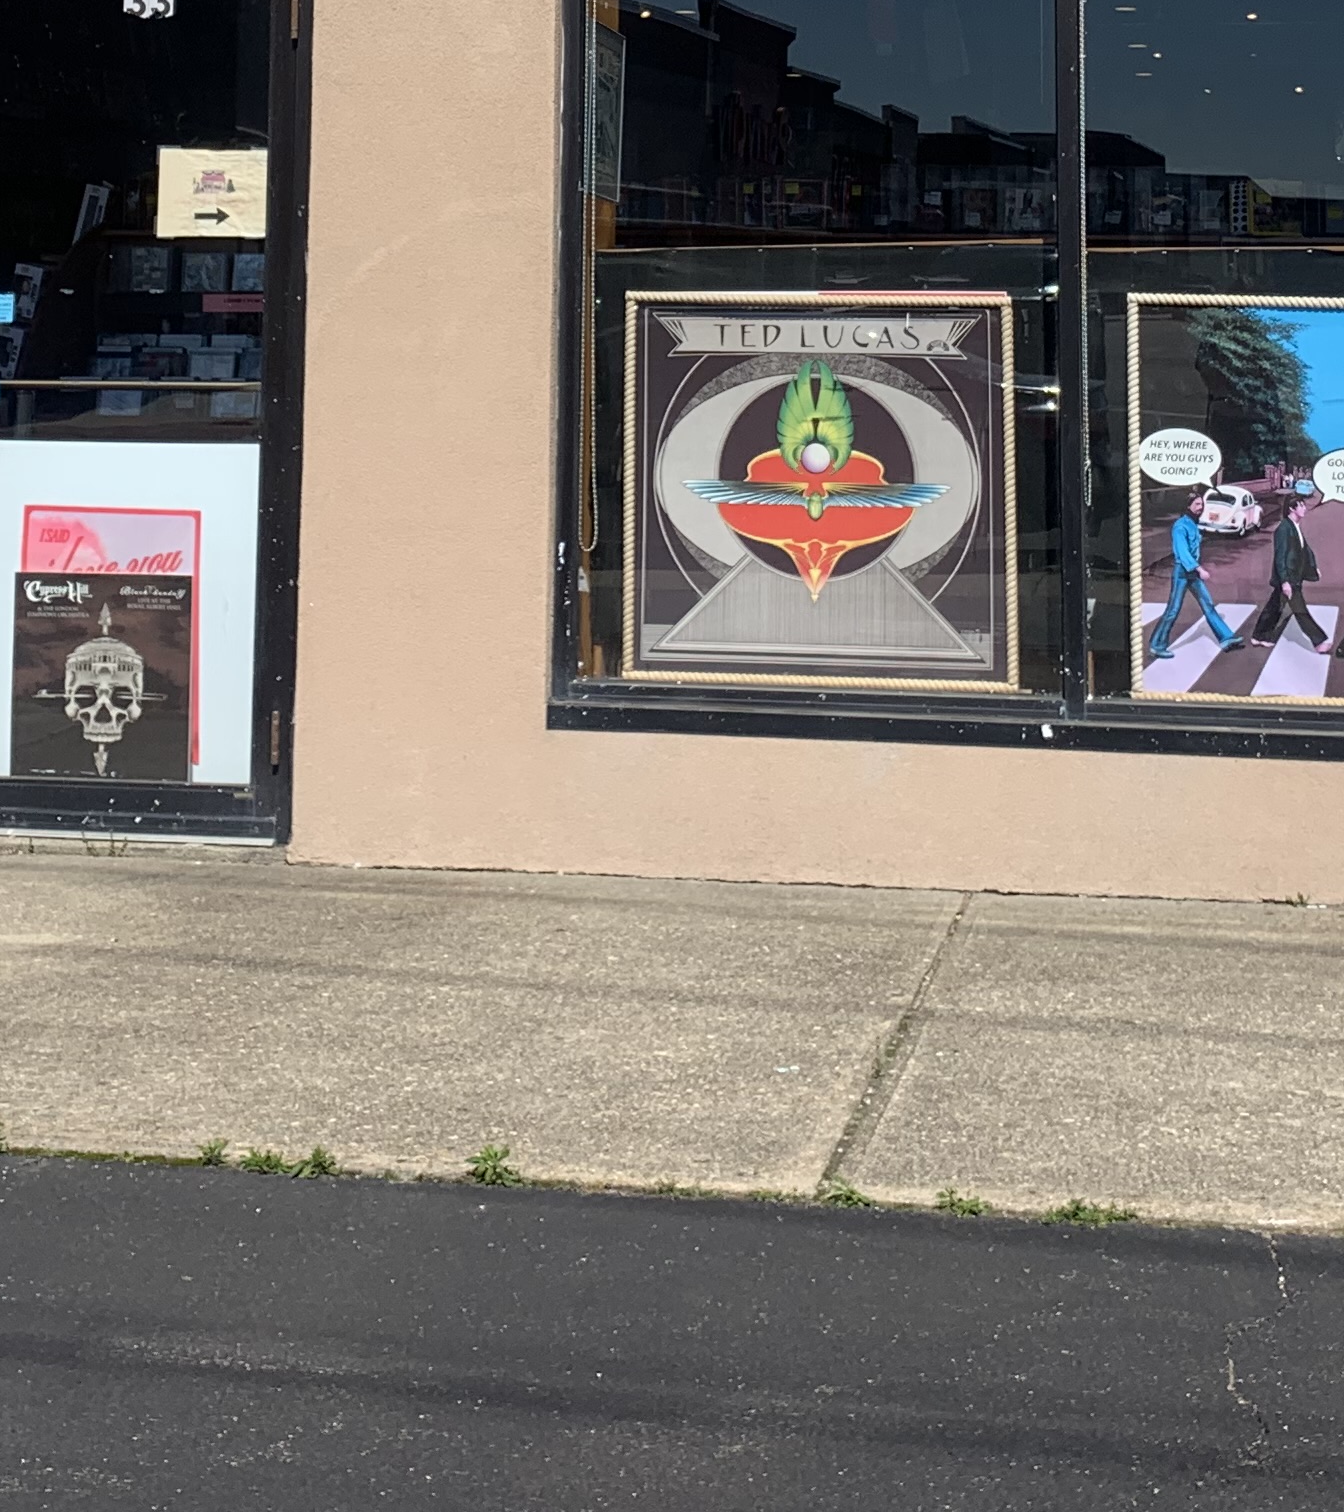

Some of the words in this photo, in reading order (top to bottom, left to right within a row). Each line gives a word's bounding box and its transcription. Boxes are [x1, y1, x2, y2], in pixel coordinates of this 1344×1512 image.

[713, 323, 781, 348] TED
[800, 325, 921, 350] LUCAS
[1150, 440, 1170, 449] HEY,
[1173, 441, 1208, 450] WHERE
[1143, 453, 1163, 462] ARE
[1165, 454, 1186, 462] YOU
[1188, 454, 1214, 463] GUYS
[1160, 467, 1199, 476] GOING?
[45, 529, 71, 543] SAID
[23, 580, 67, 604] Cypress
[66, 580, 93, 604] Hill
